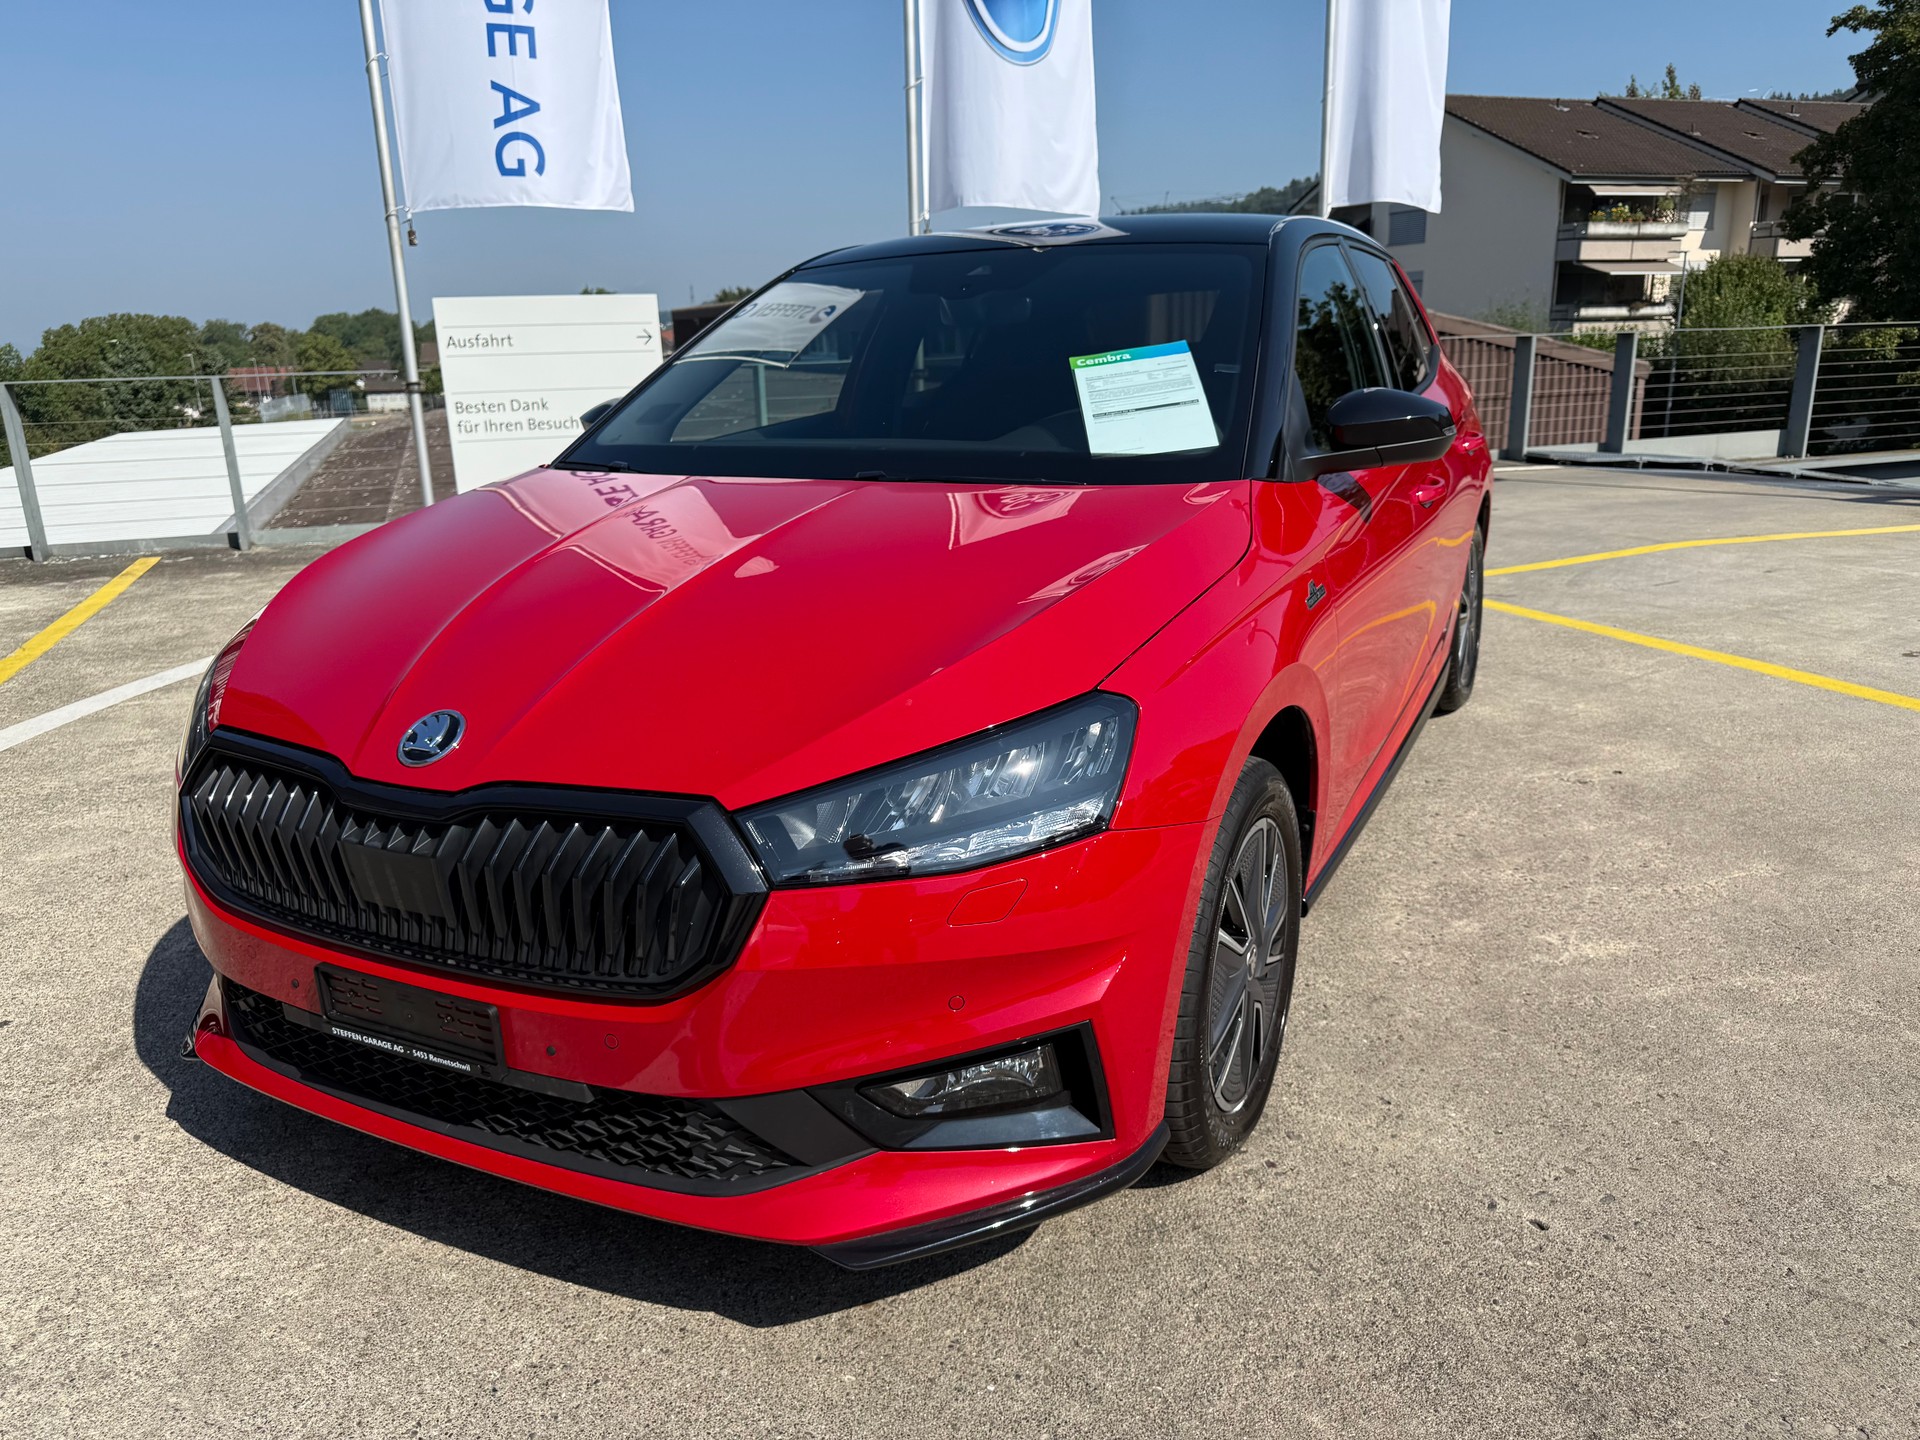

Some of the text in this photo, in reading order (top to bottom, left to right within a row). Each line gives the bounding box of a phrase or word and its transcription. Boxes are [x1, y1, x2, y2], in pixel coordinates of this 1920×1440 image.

[490, 80, 546, 177] AG
[447, 334, 514, 349] Ausfahrt
[1076, 352, 1132, 366] Cembra
[455, 398, 549, 414] Besten Dank
[457, 416, 580, 434] für Ihren Besuch
[332, 1027, 362, 1041] STEFFEN
[362, 1035, 393, 1050] GARAGE
[393, 1044, 404, 1053] AG
[412, 1049, 428, 1060] 5453
[429, 1054, 471, 1072] Remetschwil
